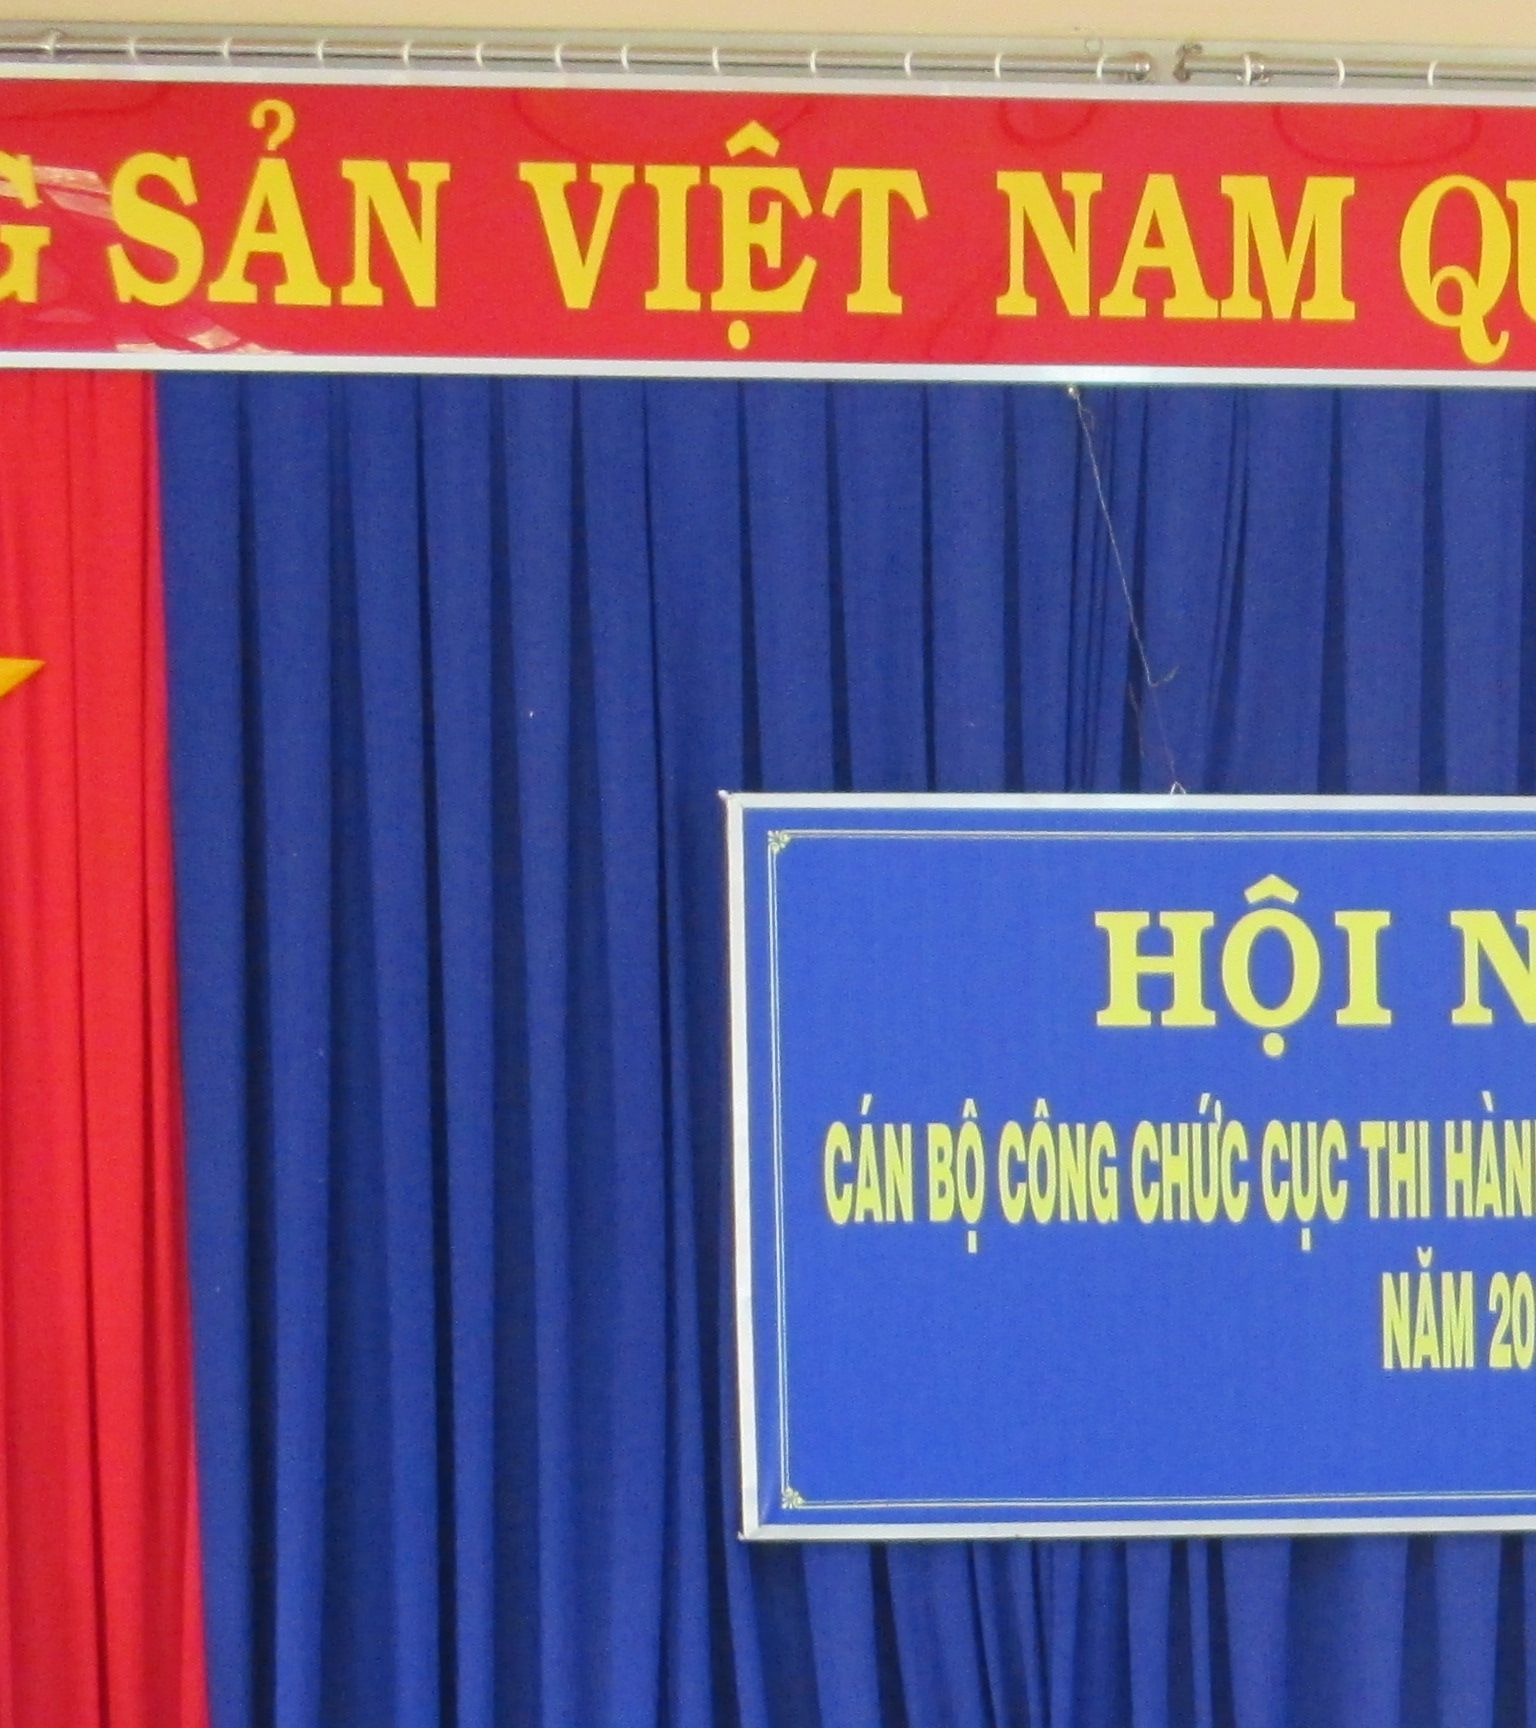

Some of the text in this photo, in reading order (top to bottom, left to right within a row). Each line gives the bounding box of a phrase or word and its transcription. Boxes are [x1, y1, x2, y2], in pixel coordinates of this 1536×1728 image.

[107, 99, 450, 308] SẢN
[519, 121, 928, 350] VIỆT
[996, 171, 1355, 321] NAM
[1095, 874, 1392, 1058] HỘI
[824, 1094, 913, 1225] CÁN
[927, 1098, 985, 1253] BỘ
[998, 1098, 1119, 1224] CÔNG
[1132, 1093, 1249, 1224] CHỨC
[1262, 1119, 1348, 1251] CỤC
[1360, 1120, 1430, 1219] THI
[1382, 1247, 1474, 1370] NĂM
